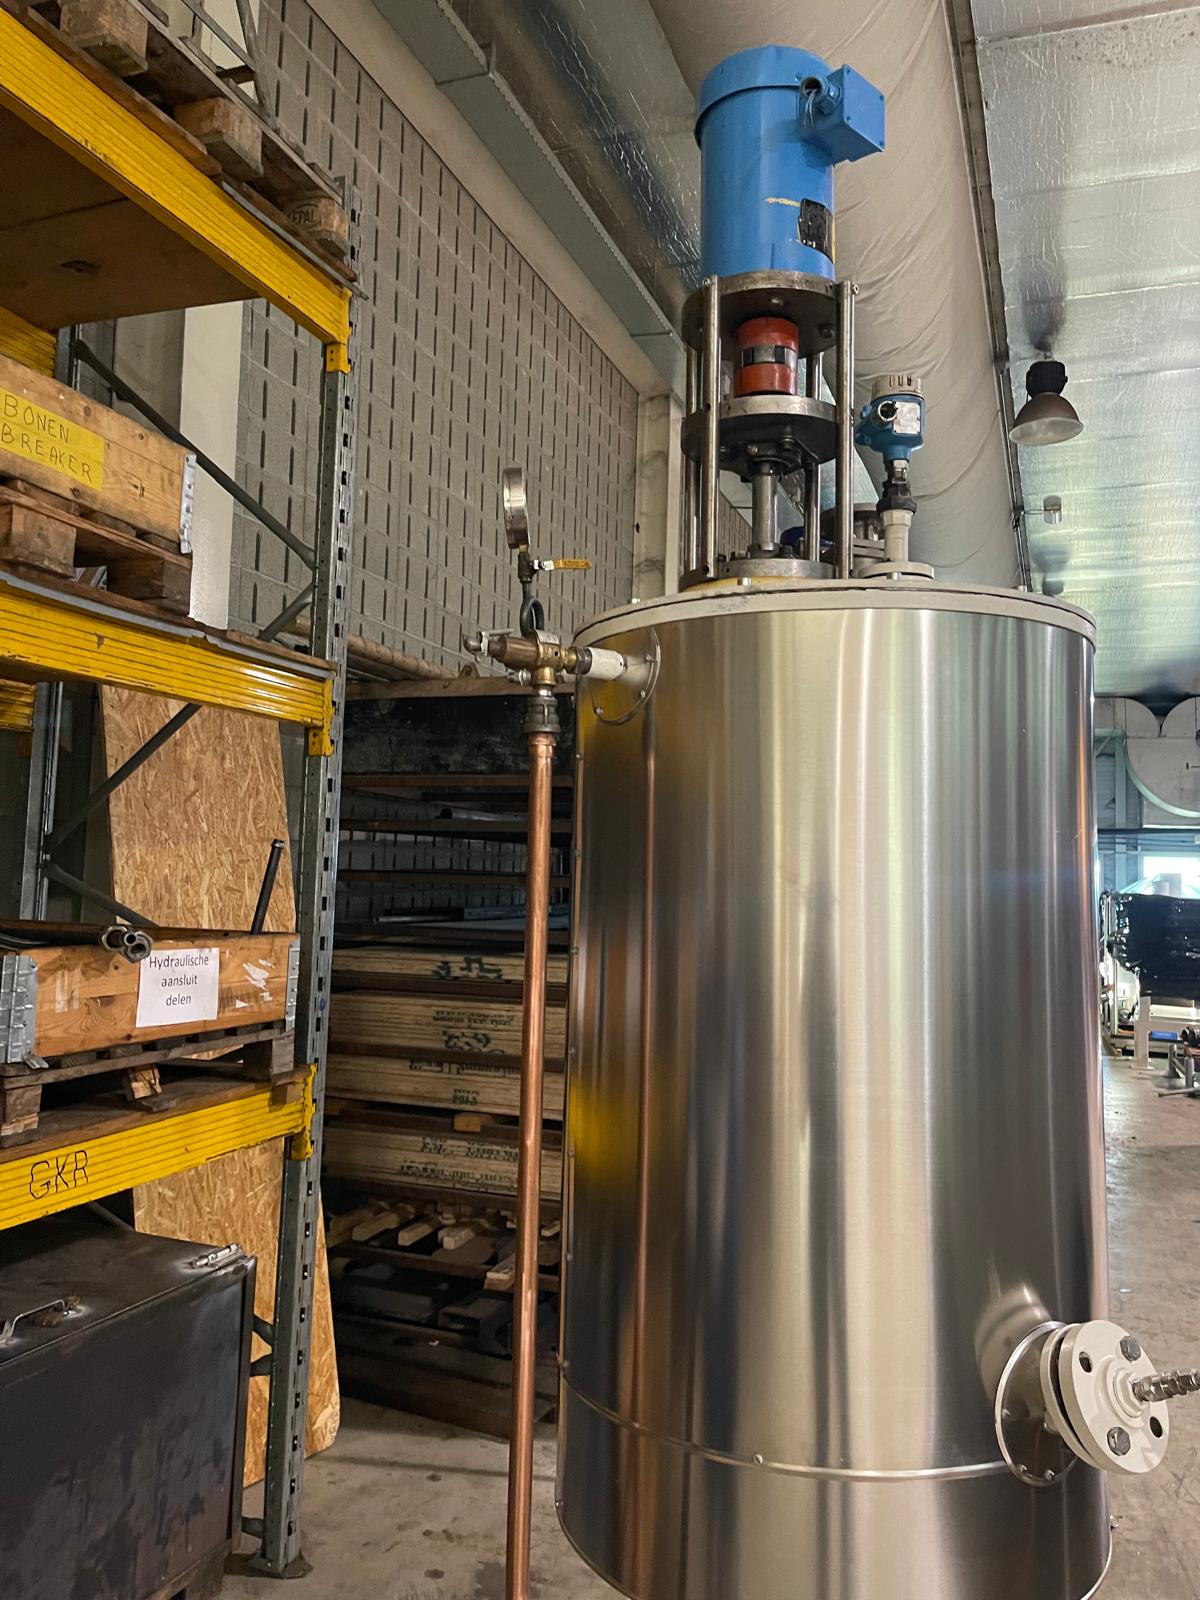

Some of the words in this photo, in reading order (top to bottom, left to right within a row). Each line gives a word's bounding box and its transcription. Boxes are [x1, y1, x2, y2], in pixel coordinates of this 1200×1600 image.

[3, 394, 69, 443] BONEN
[1, 422, 92, 482] BREAKER
[149, 955, 209, 970] Hydraulische
[161, 975, 198, 988] aansluit
[165, 993, 192, 1007] delen
[29, 1149, 88, 1200] GKR
